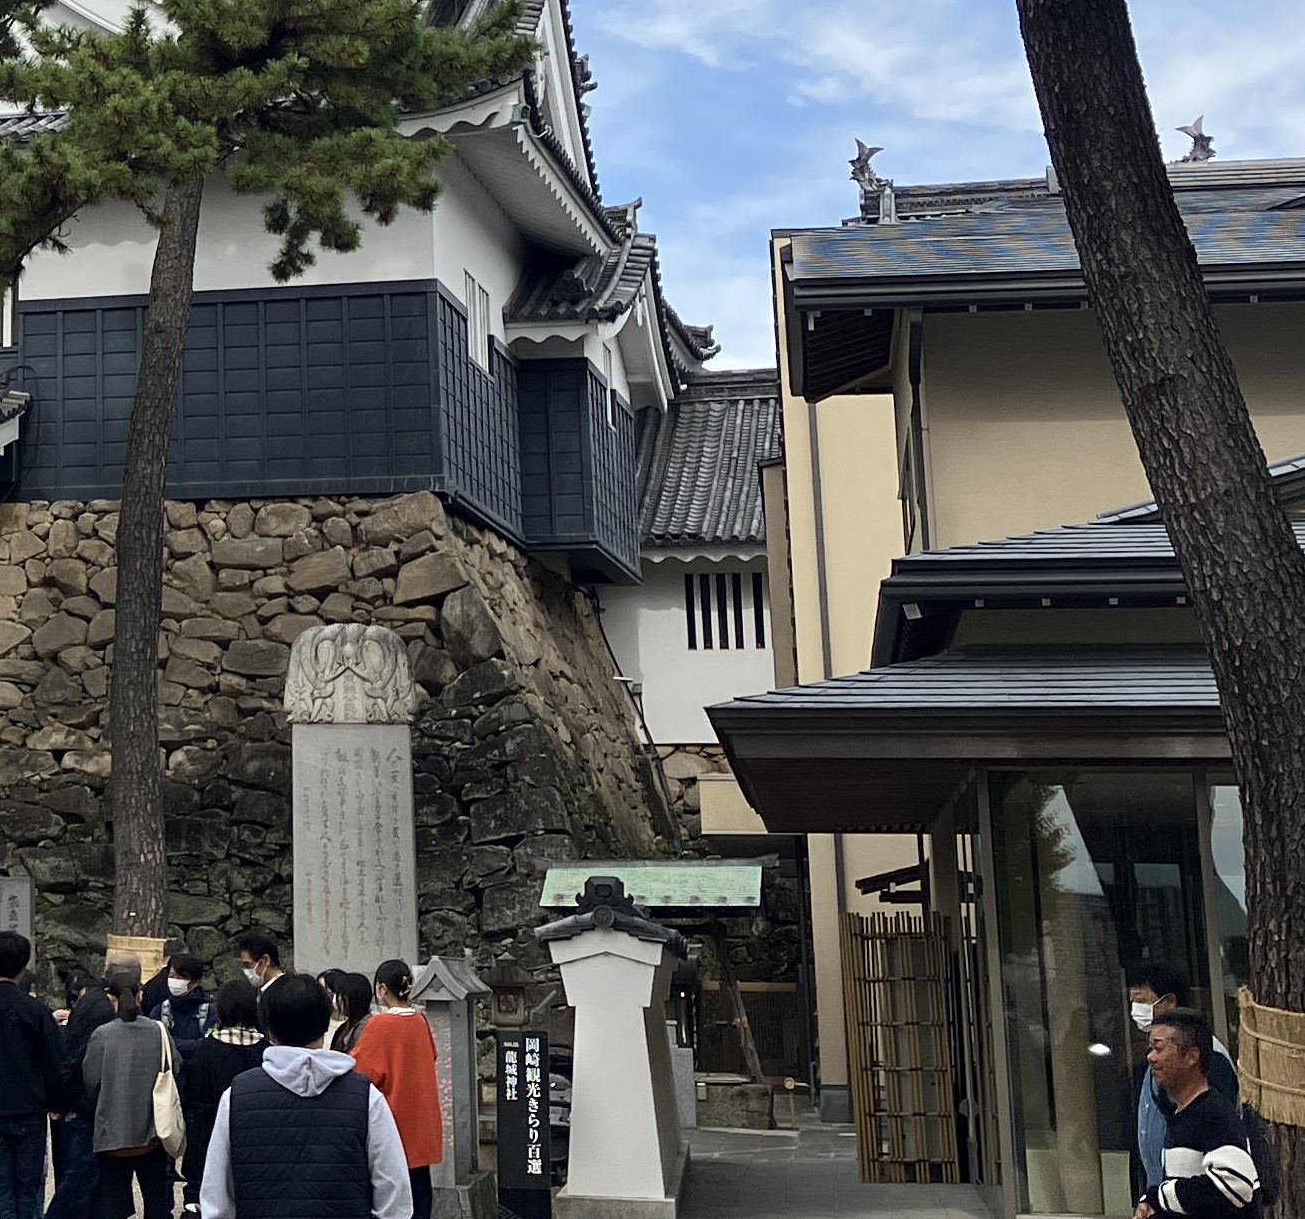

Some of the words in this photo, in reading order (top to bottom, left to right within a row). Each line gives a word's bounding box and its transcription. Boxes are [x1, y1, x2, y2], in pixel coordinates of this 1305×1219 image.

[505, 1050, 518, 1101] 龍城神社
[525, 1037, 542, 1175] 岡崎観光きらり百選
